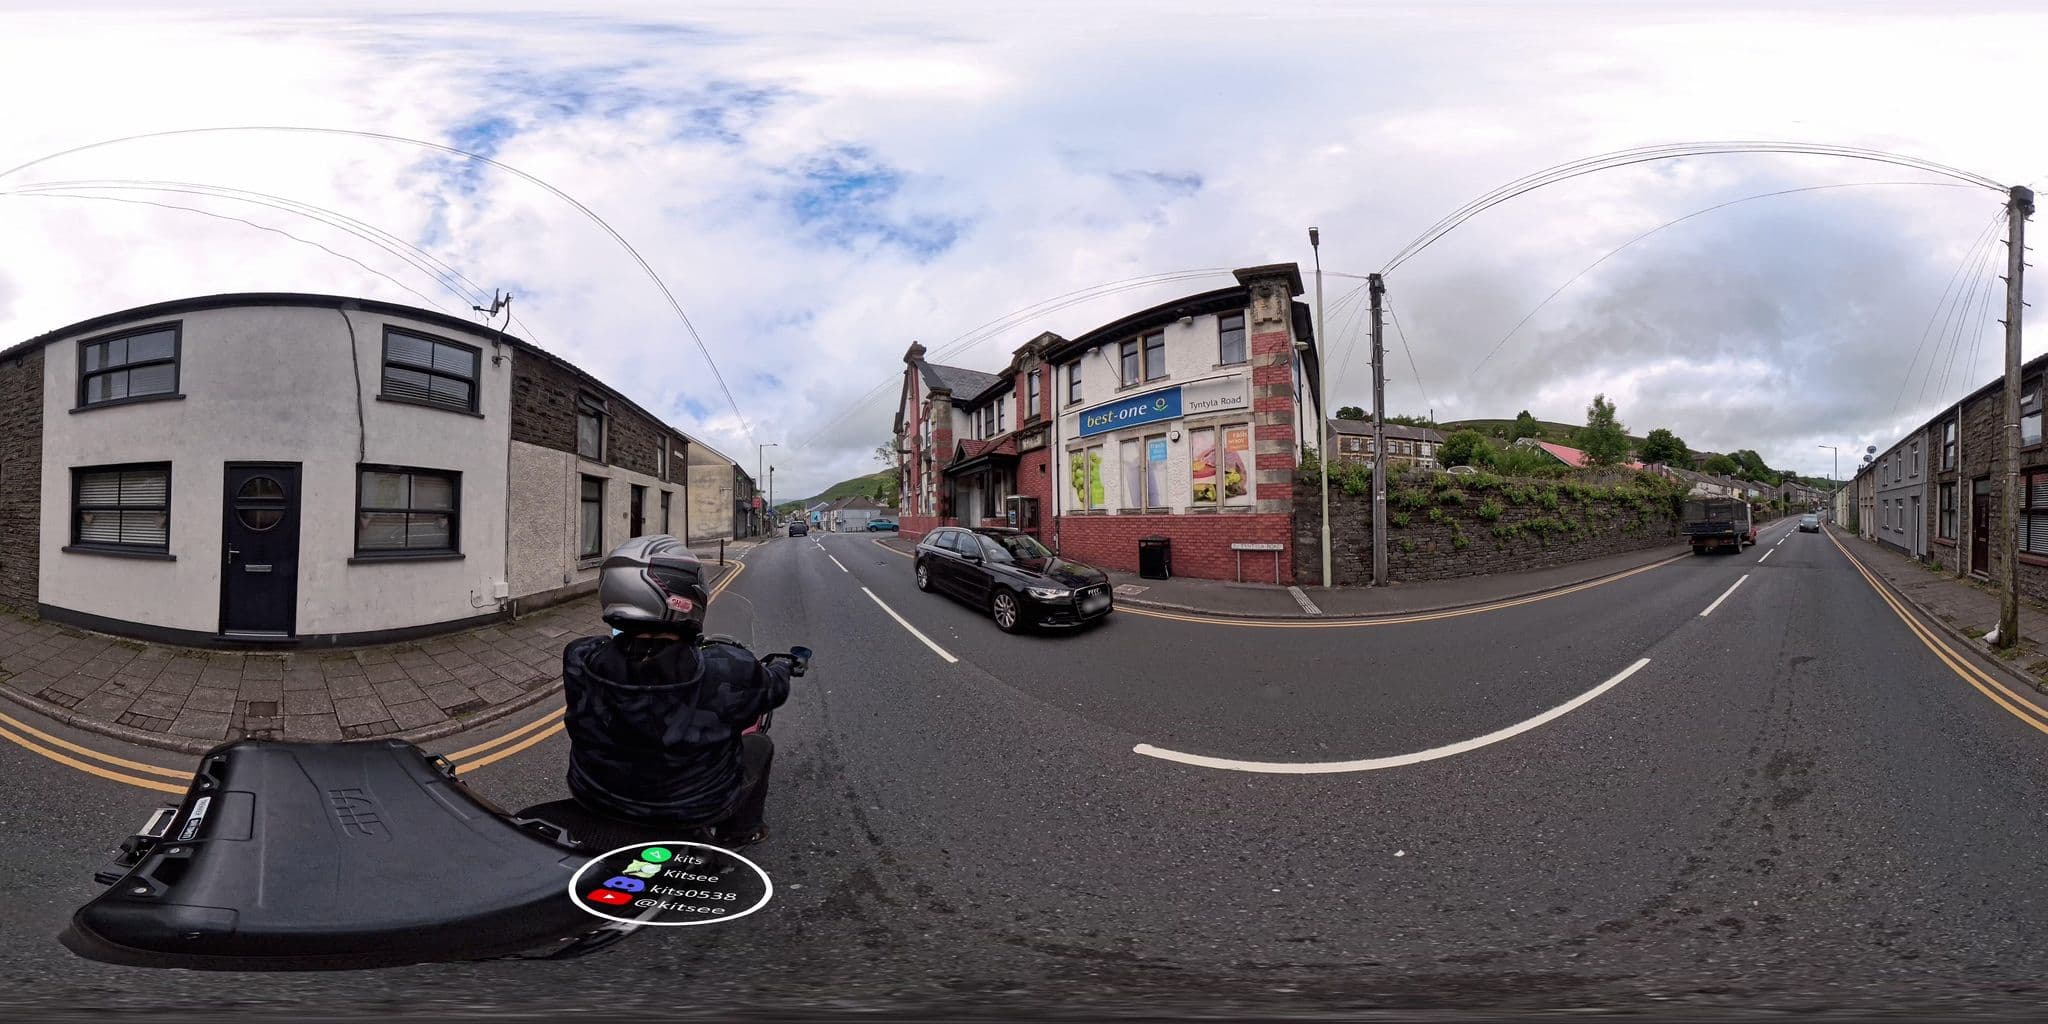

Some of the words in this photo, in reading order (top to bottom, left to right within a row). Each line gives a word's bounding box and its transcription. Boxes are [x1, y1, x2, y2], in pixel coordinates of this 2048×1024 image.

[1190, 400, 1219, 411] Tyntyla
[1220, 395, 1242, 405] Road
[1087, 404, 1147, 428] best-one
